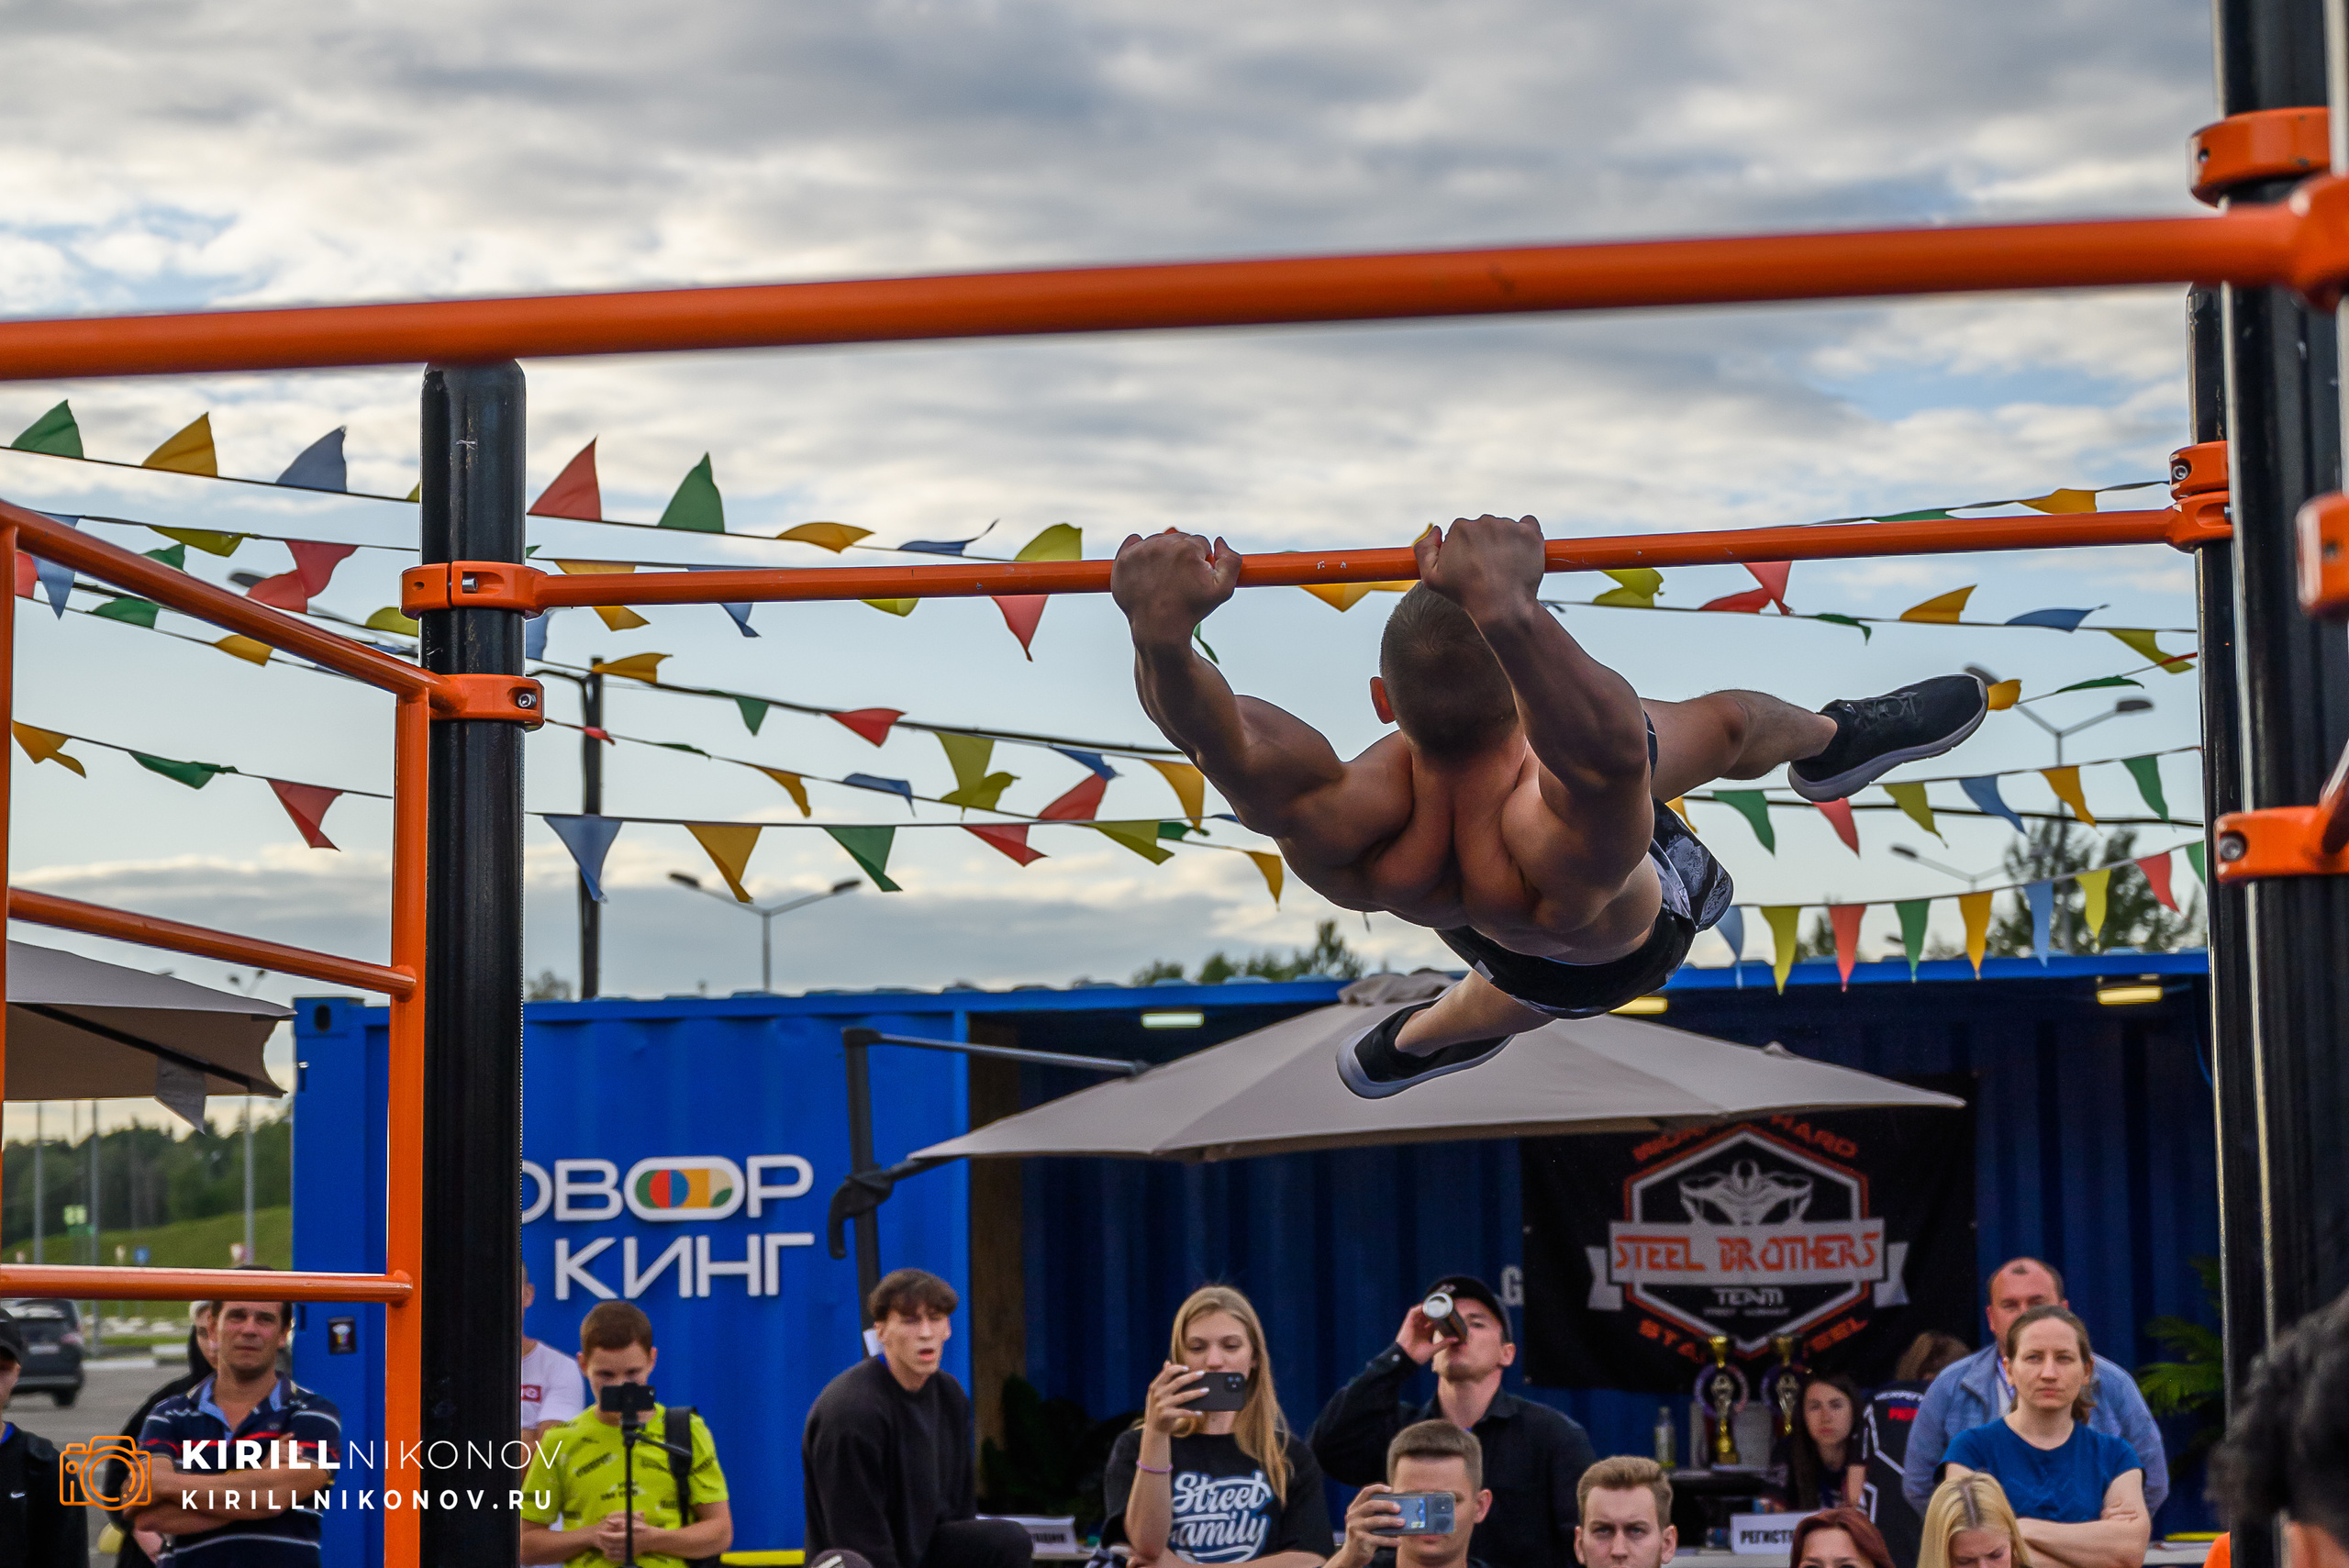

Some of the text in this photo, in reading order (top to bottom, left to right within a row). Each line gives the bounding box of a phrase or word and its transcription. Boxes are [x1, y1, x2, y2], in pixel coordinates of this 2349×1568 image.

[554, 1232, 816, 1301] КИНГ
[1615, 1231, 1881, 1273] STEEL BROTHERS
[1711, 1286, 1785, 1306] TEAM
[1172, 1471, 1273, 1513] Street
